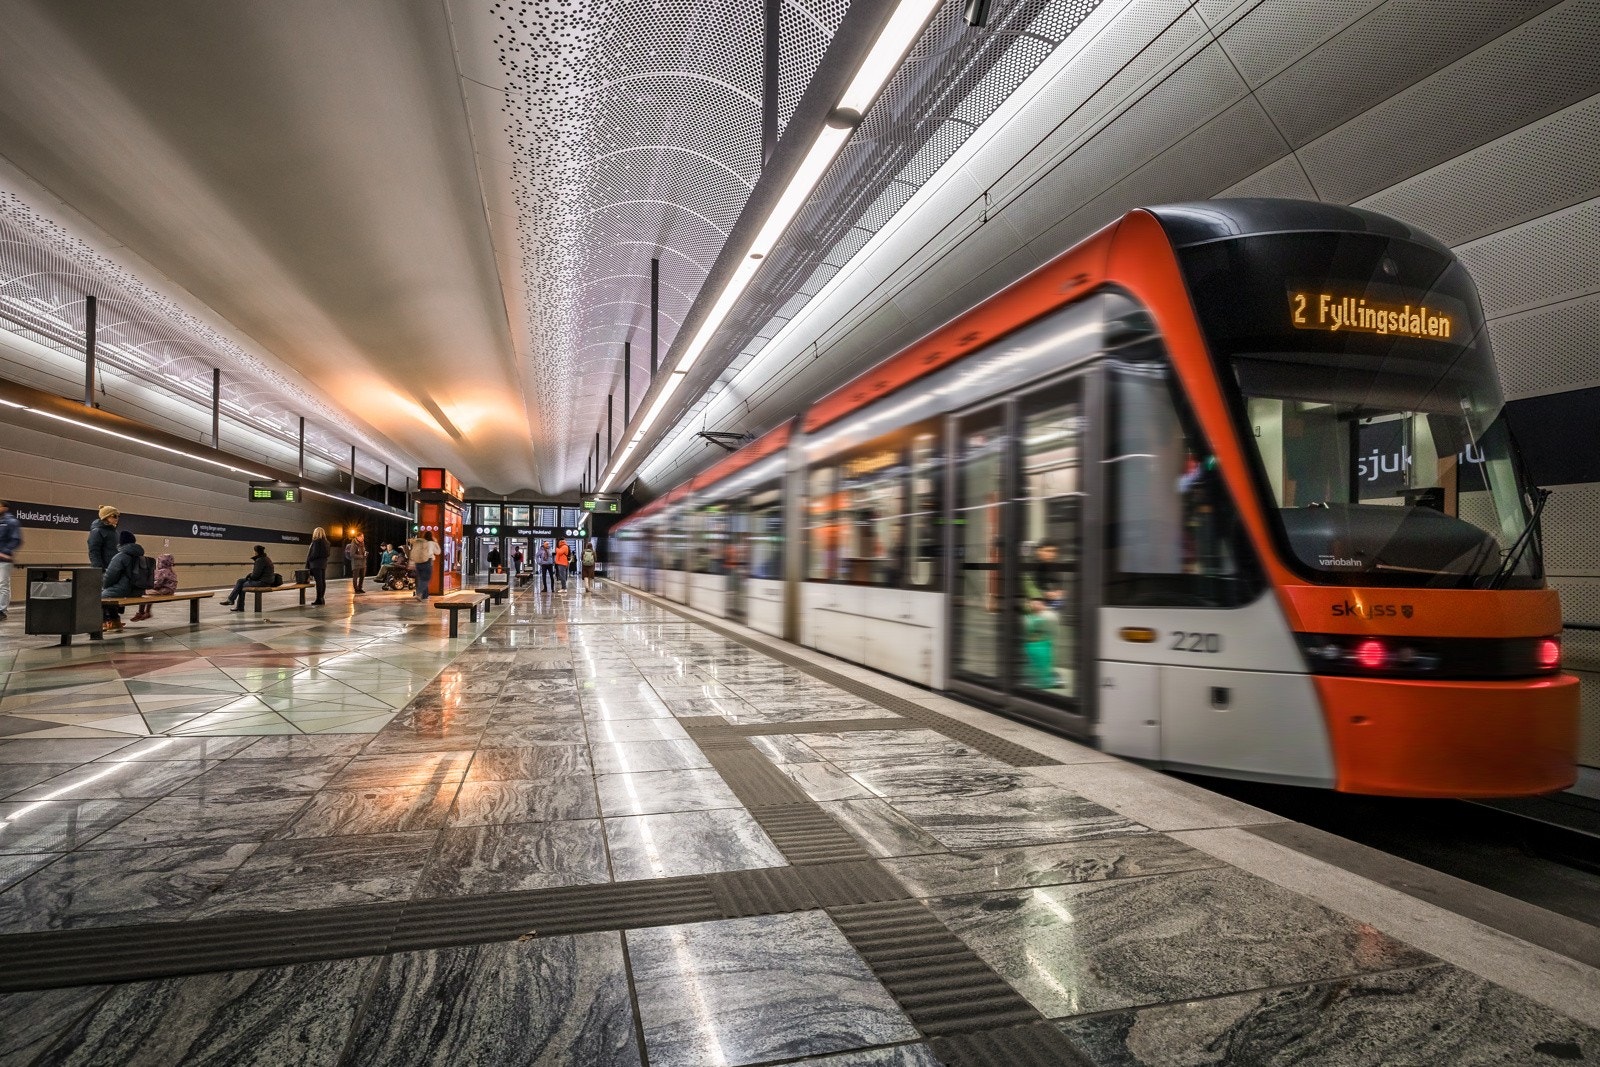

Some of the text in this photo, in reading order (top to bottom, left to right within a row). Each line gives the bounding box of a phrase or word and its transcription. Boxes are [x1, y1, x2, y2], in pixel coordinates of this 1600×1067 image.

[1294, 294, 1450, 338] 2 Fyllingsdalen
[16, 509, 79, 525] Haukeland sjukehus
[1319, 558, 1362, 567] variobahn
[1169, 631, 1222, 653] 220
